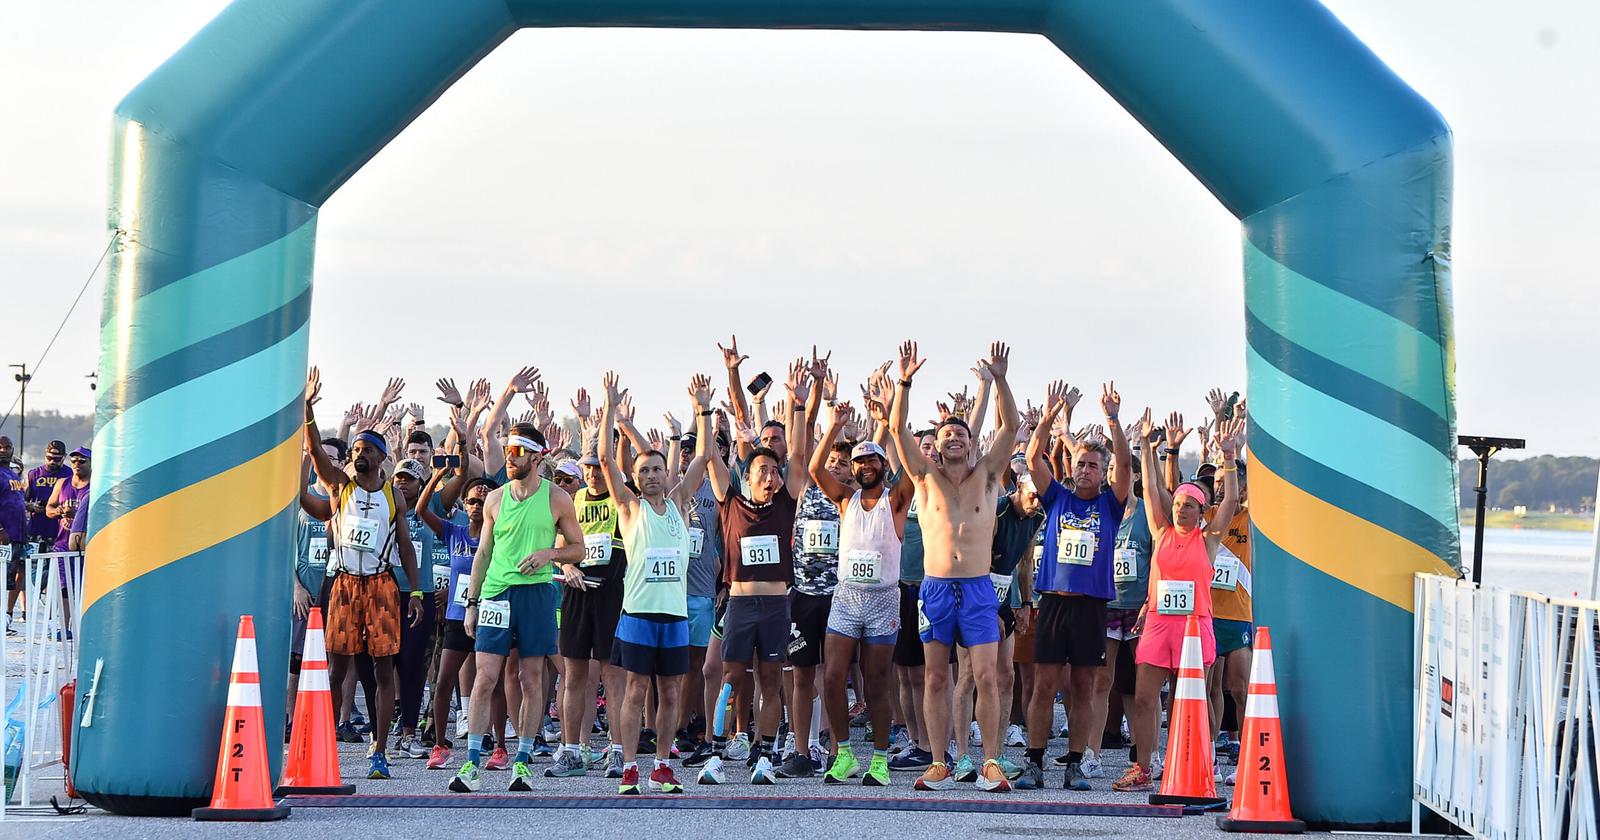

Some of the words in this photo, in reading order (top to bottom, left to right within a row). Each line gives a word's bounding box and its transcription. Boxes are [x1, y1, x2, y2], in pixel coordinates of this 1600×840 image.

[347, 528, 371, 546] 442
[809, 533, 831, 547] 914
[1236, 535, 1248, 544] 23
[749, 548, 771, 563] 931
[1065, 542, 1088, 559] 910
[652, 560, 676, 576] 416
[852, 562, 874, 578] 895
[1115, 561, 1130, 576] 28
[1213, 568, 1230, 584] 21
[1164, 593, 1187, 609] 913
[480, 610, 503, 626] 920
